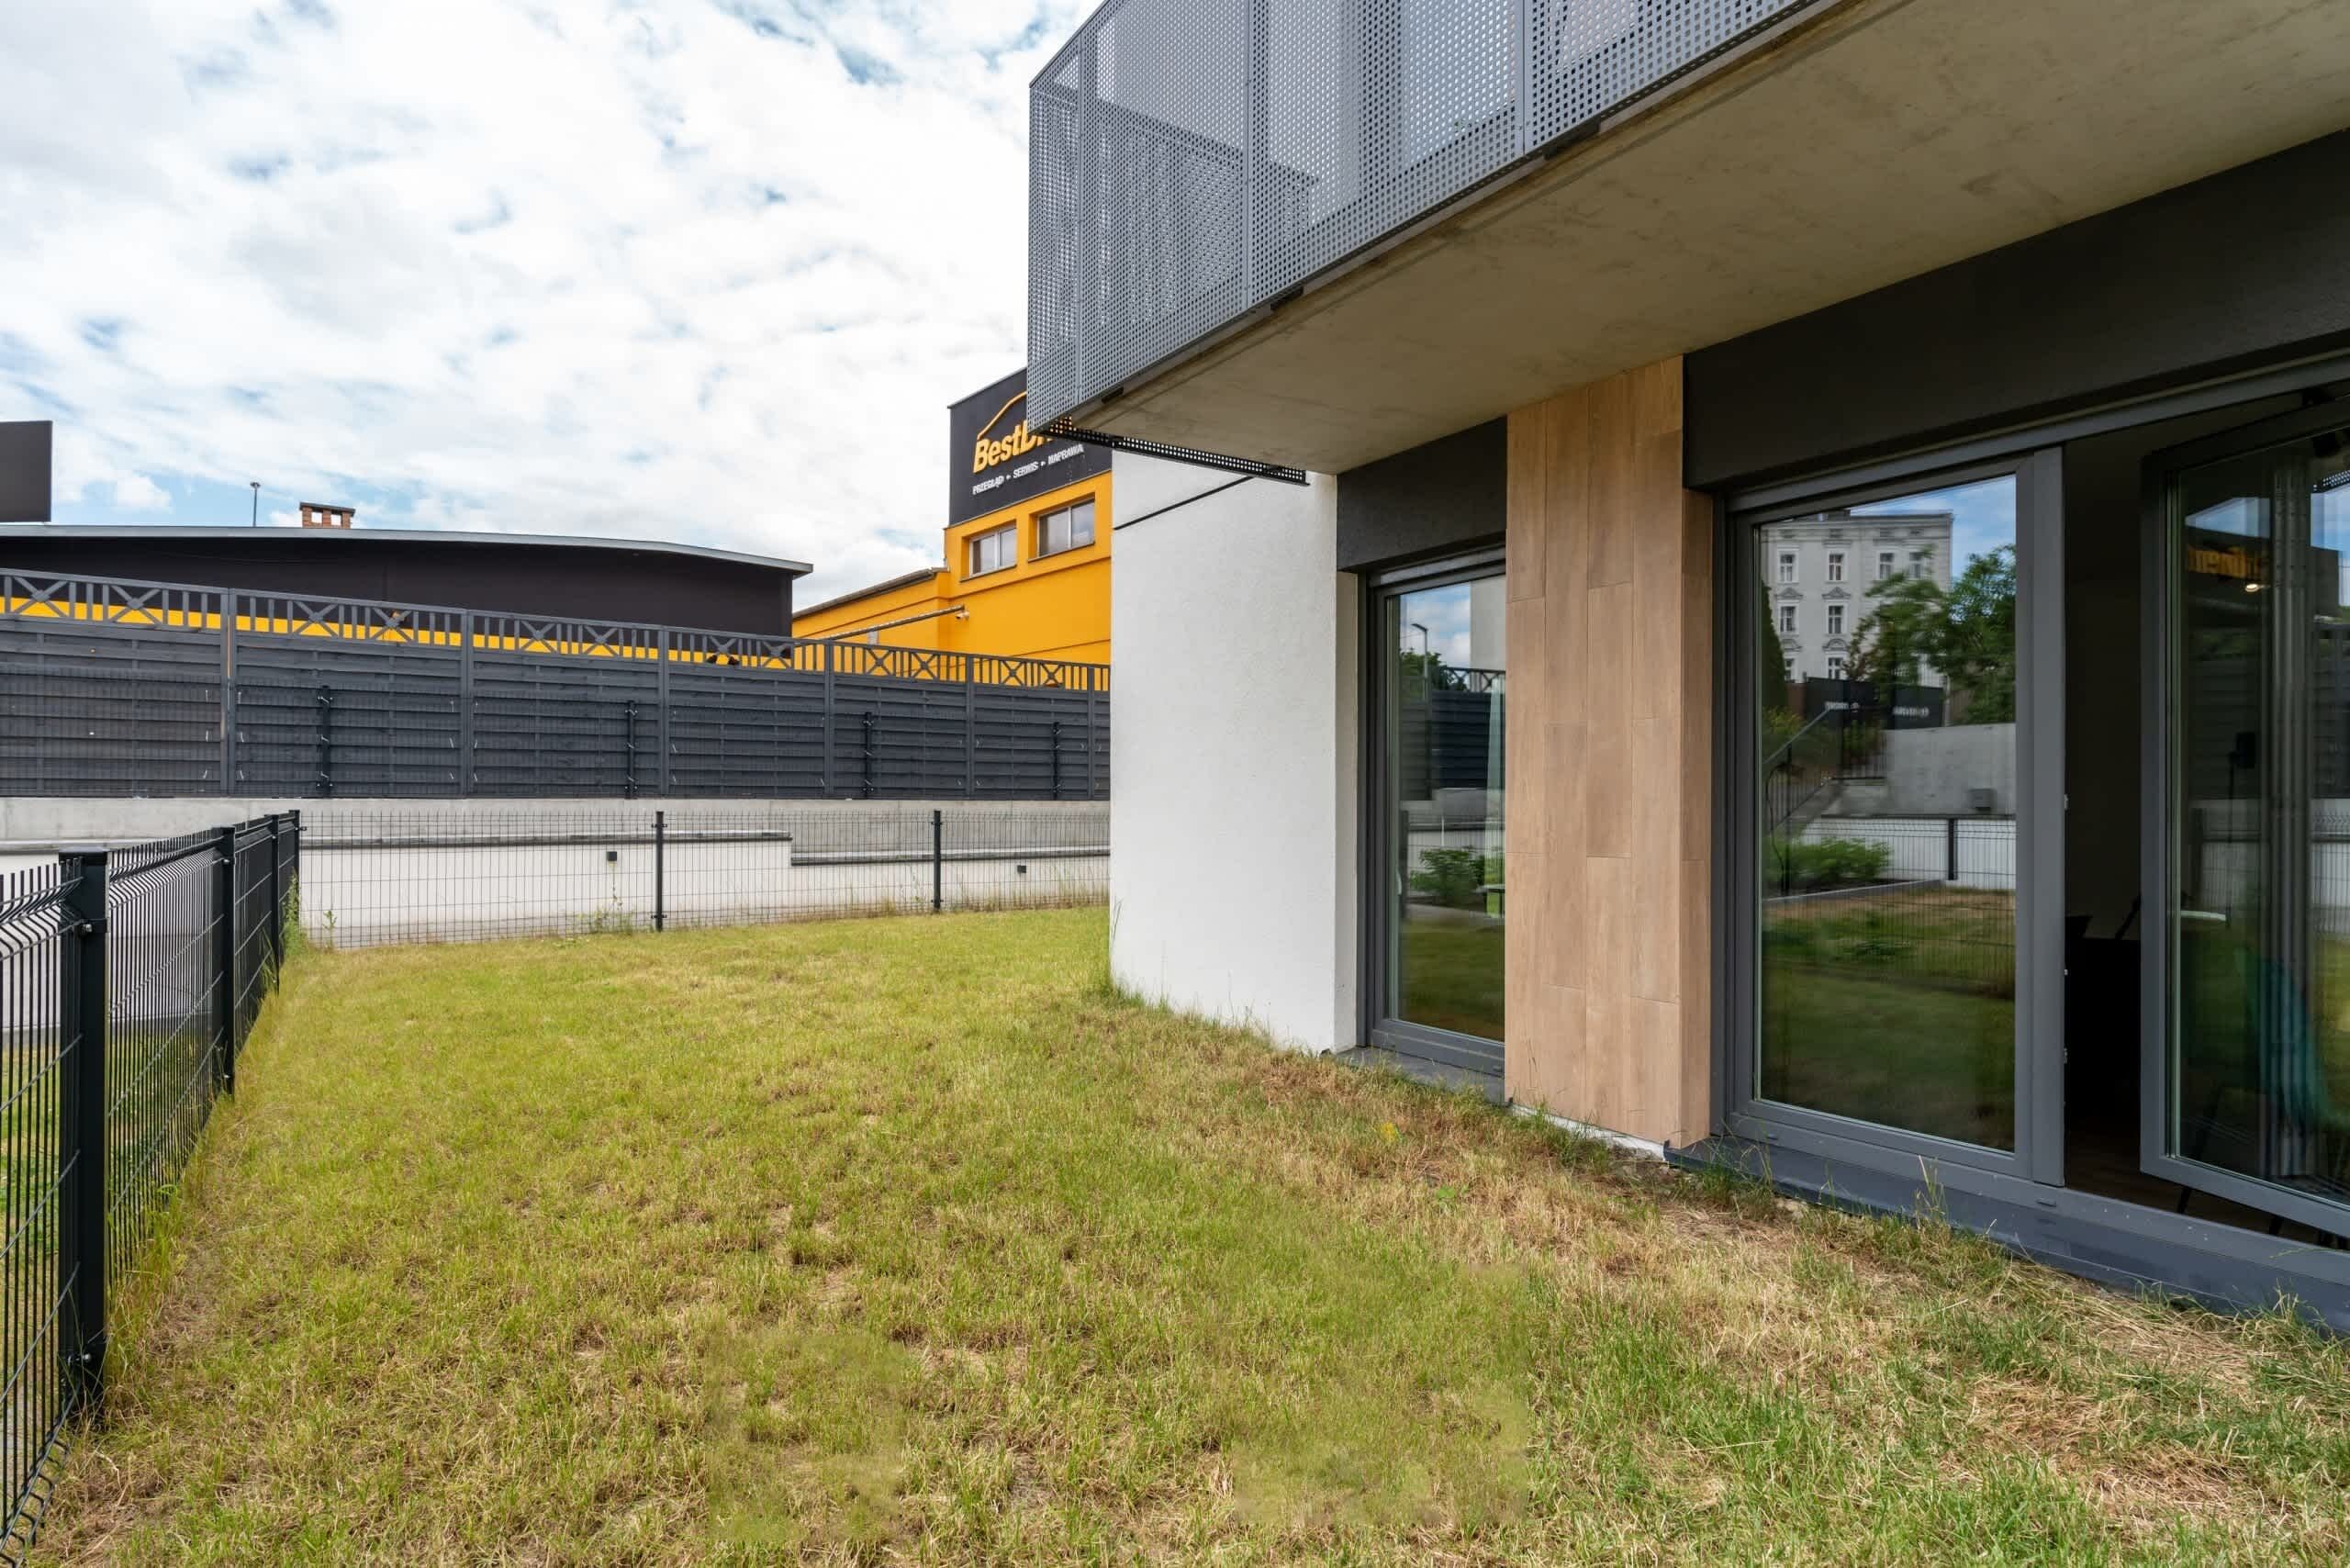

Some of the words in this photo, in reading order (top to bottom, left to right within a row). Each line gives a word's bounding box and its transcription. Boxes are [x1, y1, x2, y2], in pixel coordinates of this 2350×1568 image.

[973, 419, 1054, 473] BestD
[1013, 461, 1038, 478] SERWIS
[1047, 443, 1084, 465] NAPRAWA
